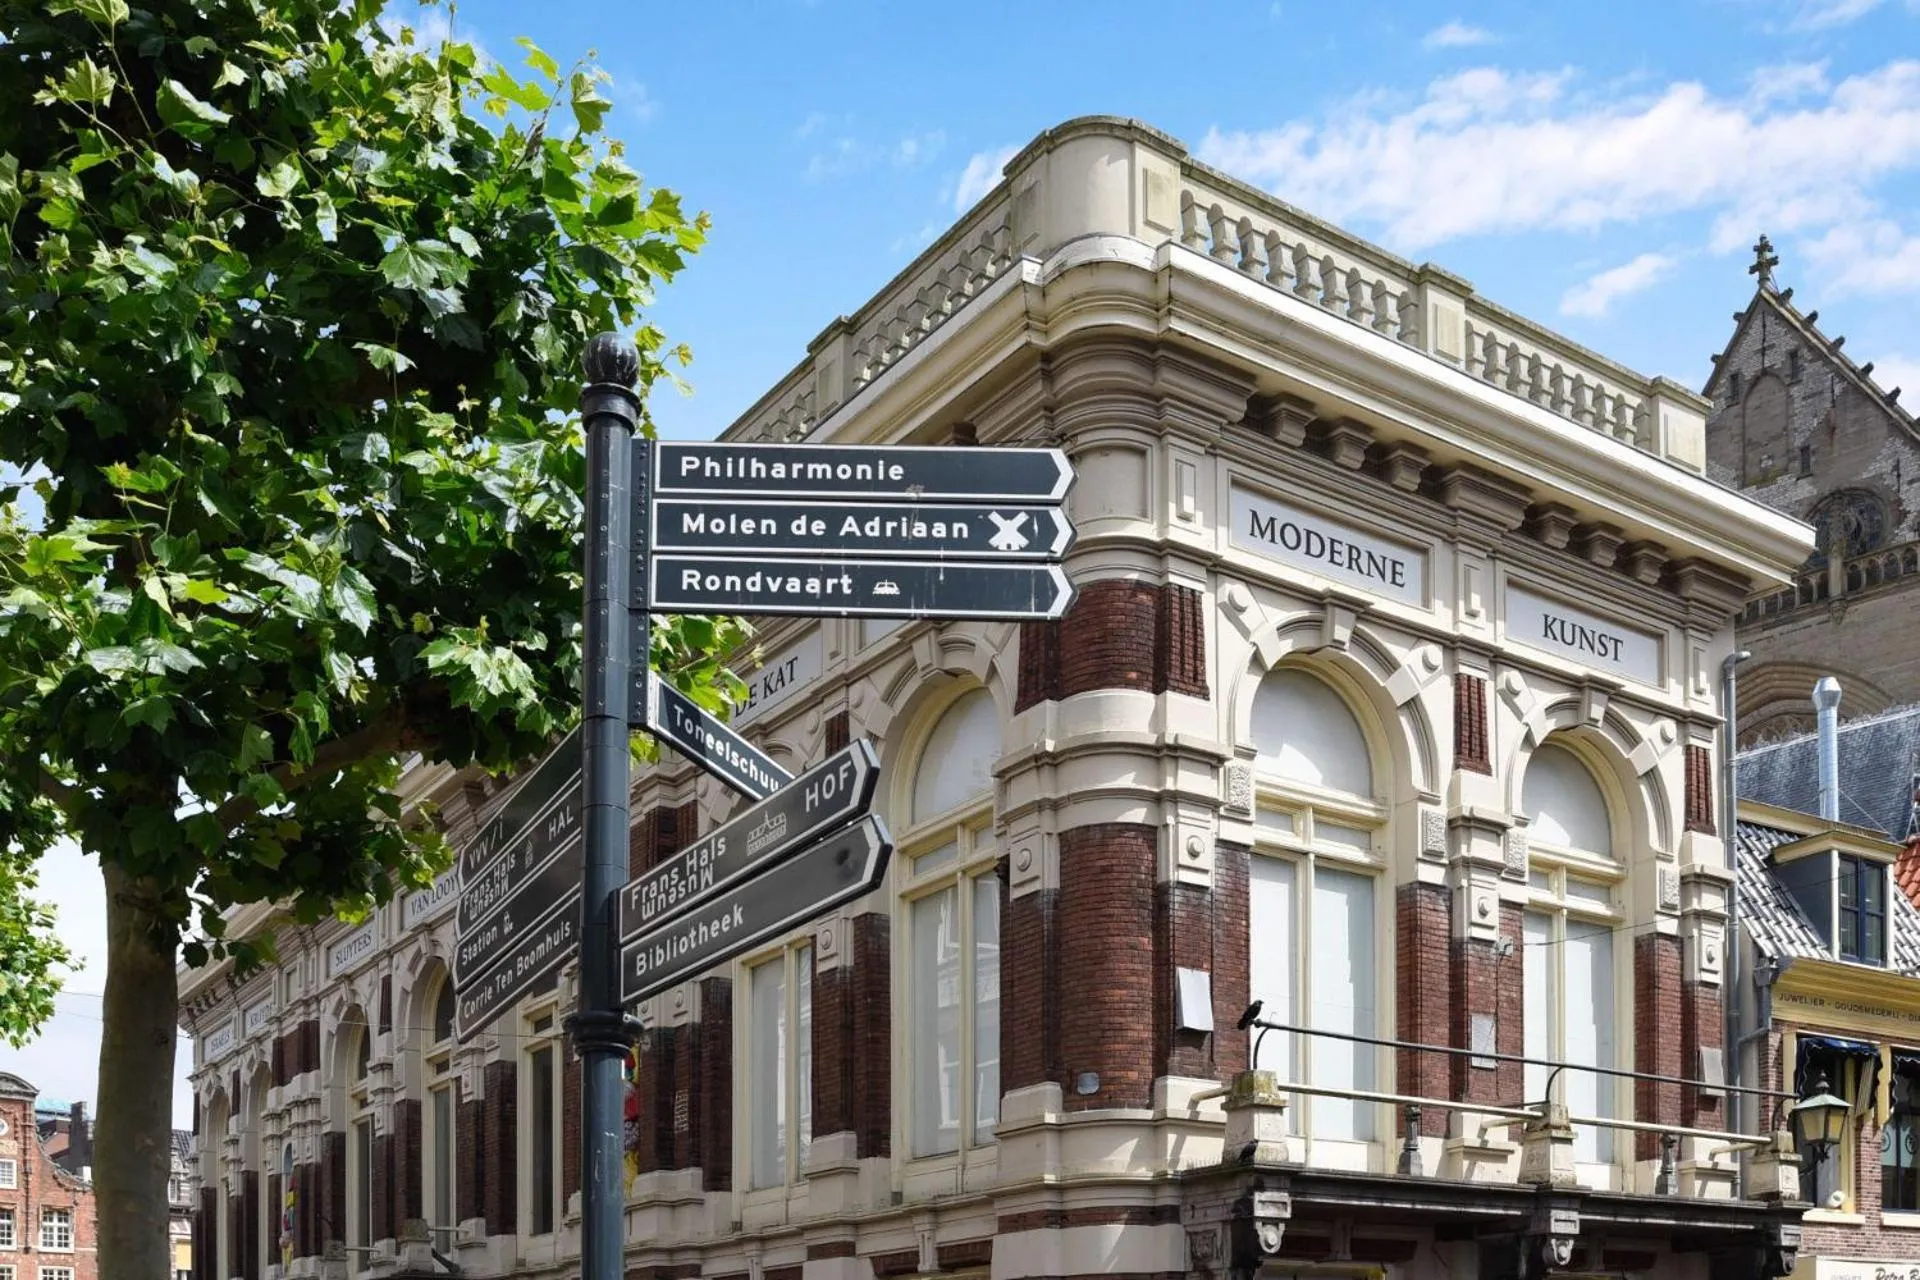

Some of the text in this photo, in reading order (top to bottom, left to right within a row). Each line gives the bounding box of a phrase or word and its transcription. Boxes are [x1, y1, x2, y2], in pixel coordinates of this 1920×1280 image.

[681, 456, 904, 480] Philharmonie
[682, 513, 969, 539] Molen de Adriaan
[1249, 509, 1405, 588] MODERNE
[681, 570, 852, 595] Rondvaart
[1542, 613, 1623, 662] KUNST
[762, 656, 798, 700] KAT
[673, 704, 783, 793] Toneelschuu
[805, 760, 852, 813] HOF
[548, 805, 574, 841] HAL
[469, 836, 489, 869] VVV
[631, 837, 726, 911] Frans Hals
[463, 852, 516, 914] Frans Hals
[462, 925, 498, 966] Station
[636, 903, 744, 977] Bibliotheek
[463, 920, 571, 1019] Corrie Ten Boomhuis
[1779, 993, 1825, 1007] JUWELIER
